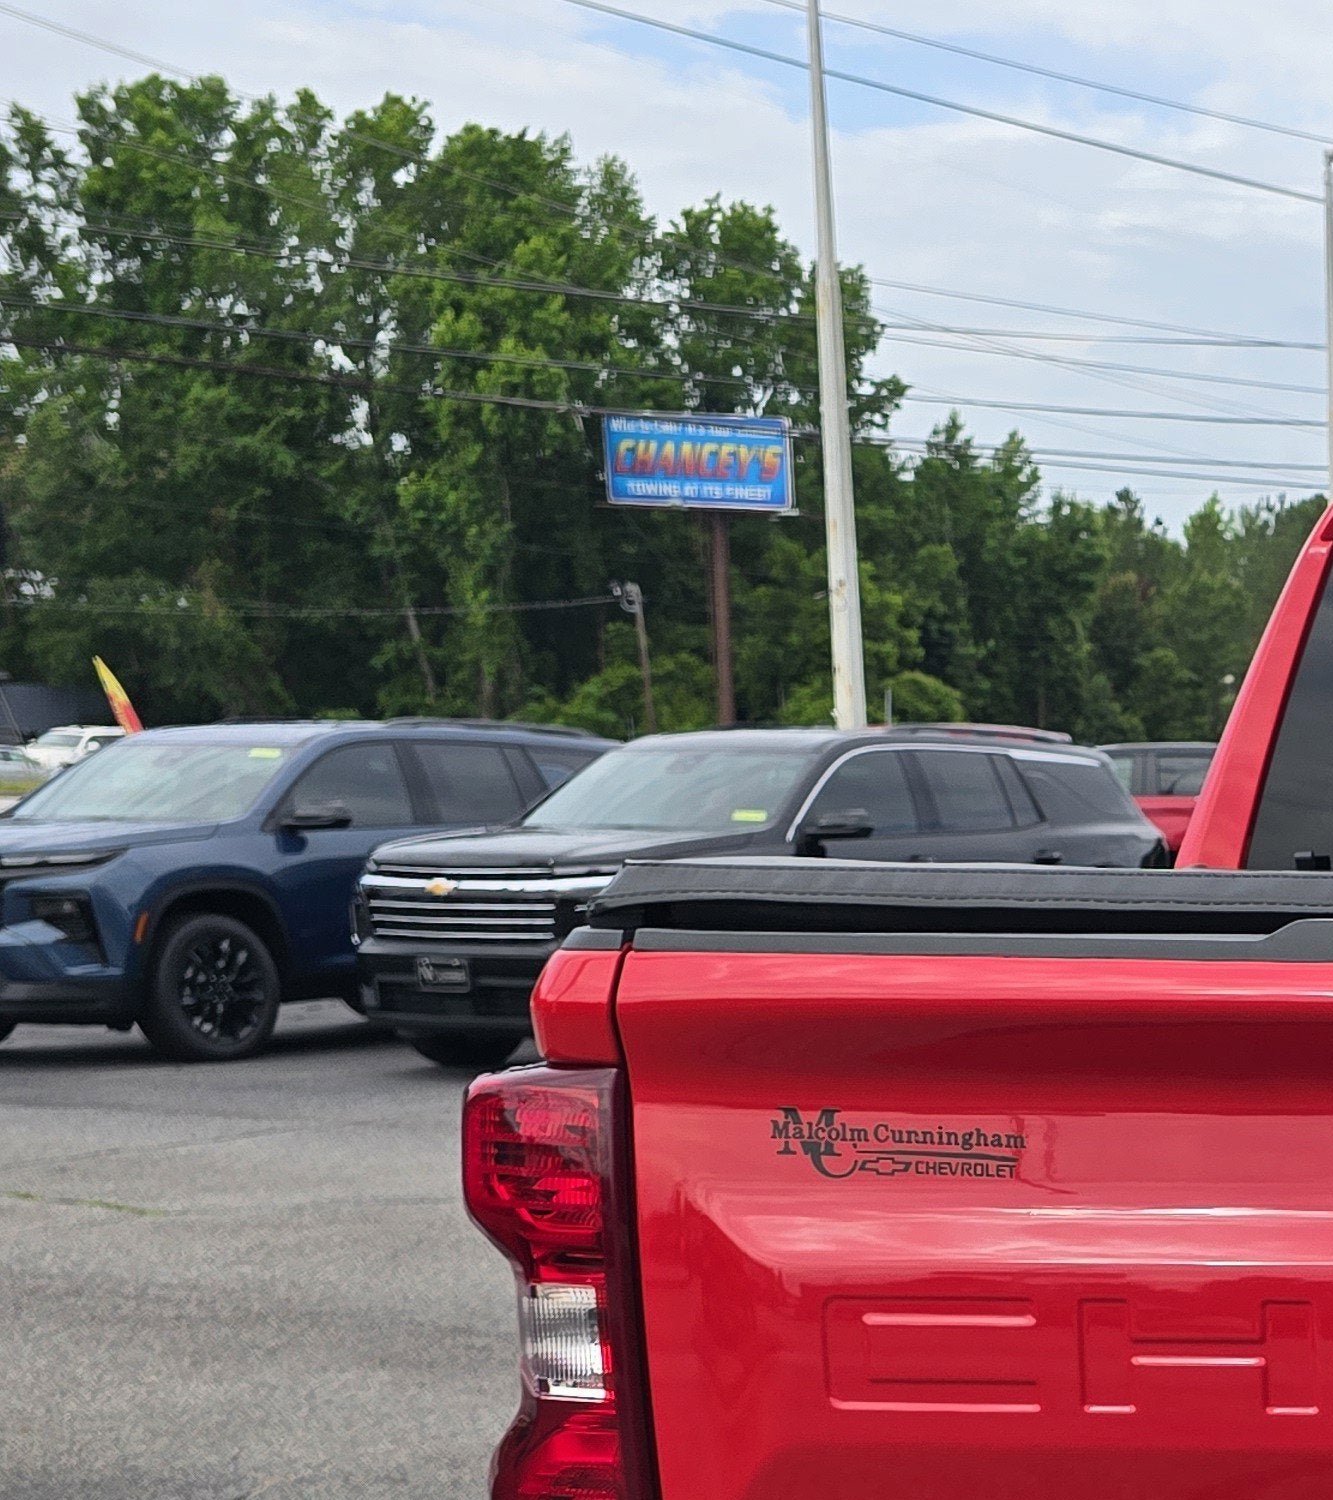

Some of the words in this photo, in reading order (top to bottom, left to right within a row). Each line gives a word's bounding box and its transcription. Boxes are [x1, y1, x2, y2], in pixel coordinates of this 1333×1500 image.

[614, 437, 782, 483] CHANCEY'S
[626, 480, 680, 498] TOWING
[770, 1118, 870, 1143] Malcolm
[873, 1123, 1027, 1150] Cunningham
[914, 1160, 1018, 1180] CHEVROLET
